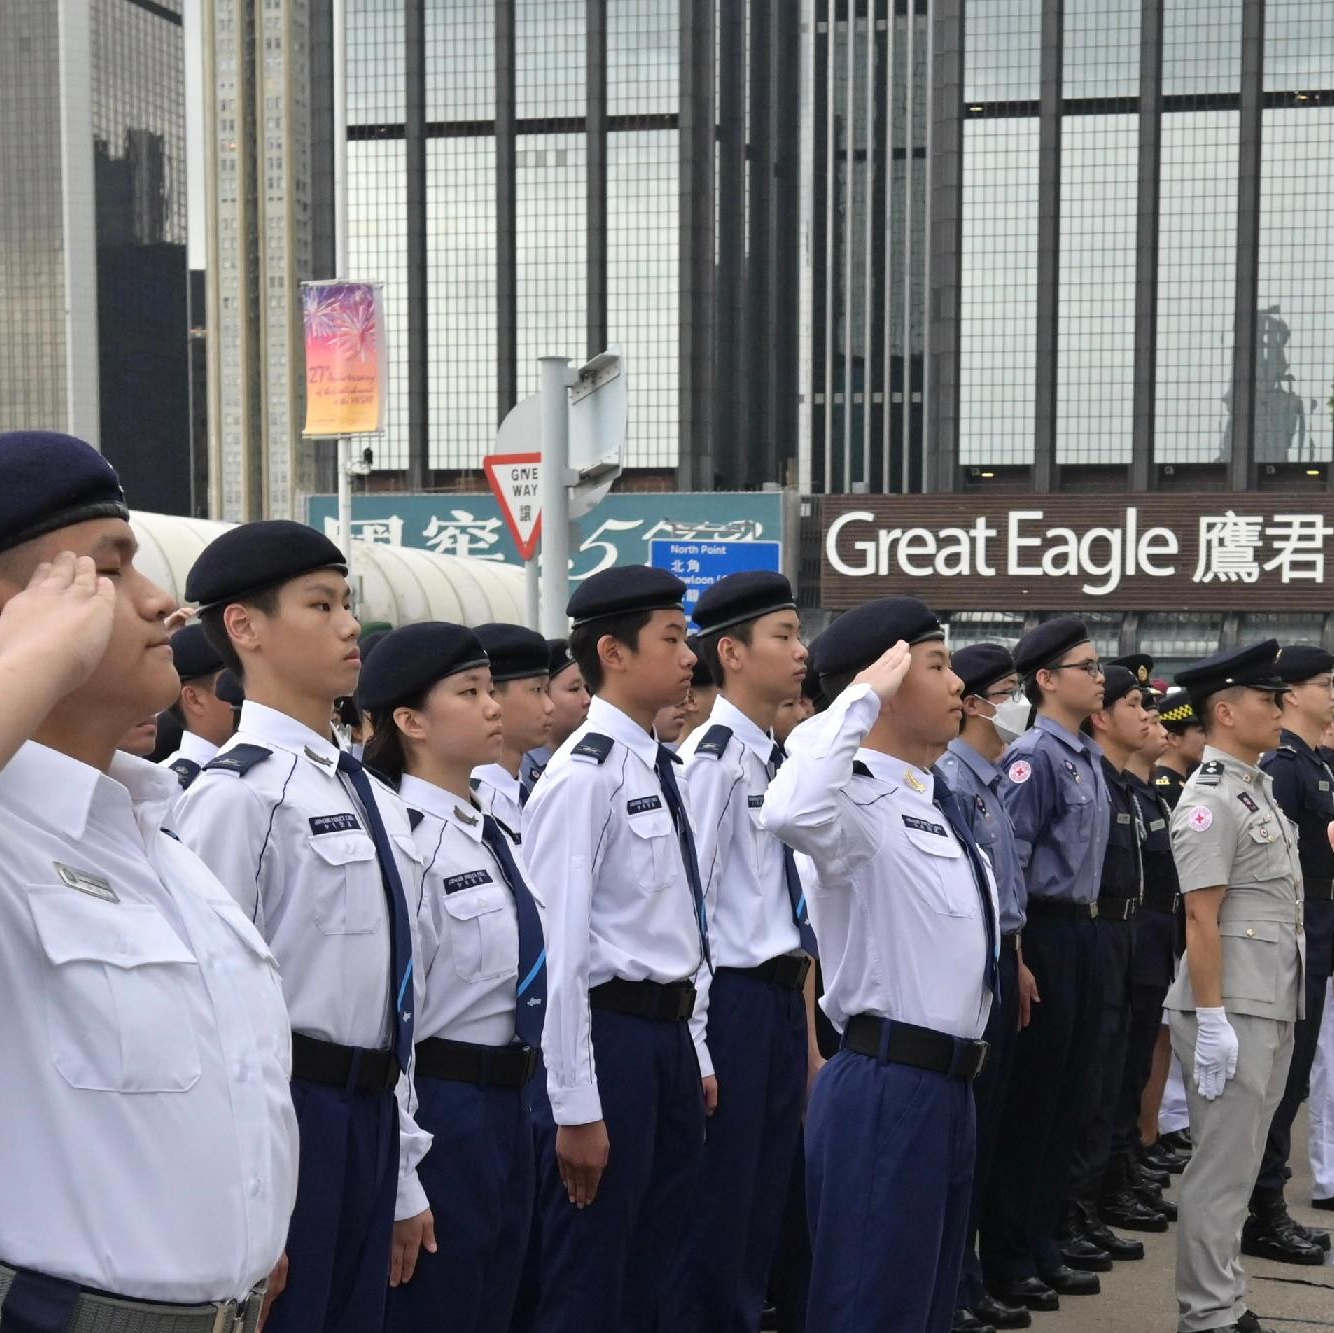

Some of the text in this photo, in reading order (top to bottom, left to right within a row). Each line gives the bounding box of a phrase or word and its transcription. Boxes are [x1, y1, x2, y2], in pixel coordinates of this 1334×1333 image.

[512, 468, 538, 480] GIVE
[512, 484, 538, 496] WAY
[670, 545, 727, 555] North Point
[825, 506, 1334, 596] Great Eagle 鷹君
[671, 559, 700, 573] 北角
[675, 575, 714, 585] owloon
